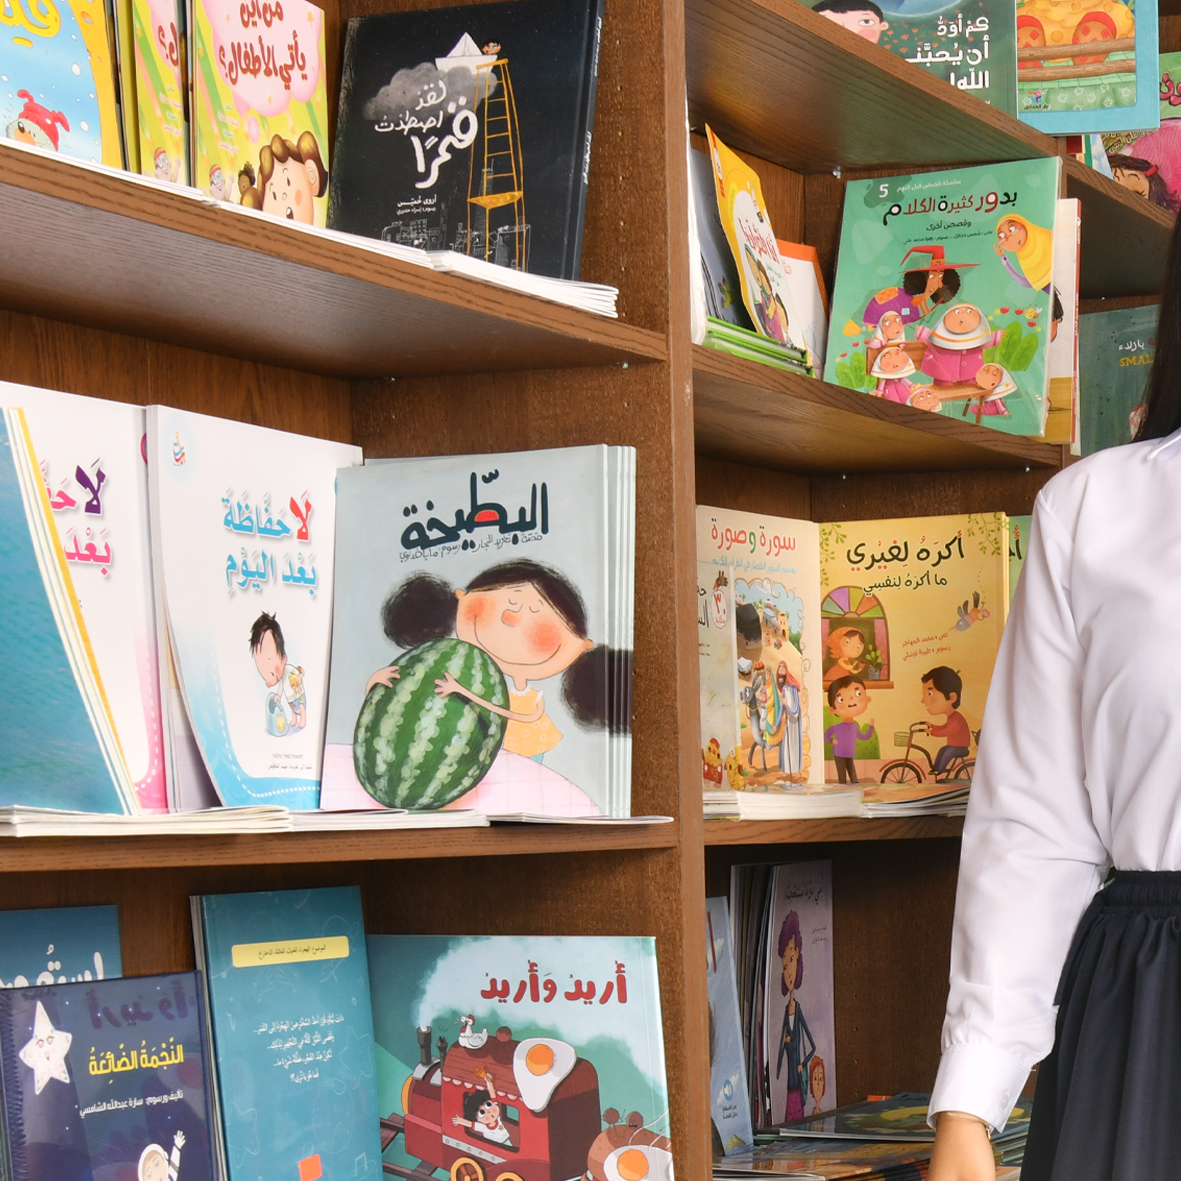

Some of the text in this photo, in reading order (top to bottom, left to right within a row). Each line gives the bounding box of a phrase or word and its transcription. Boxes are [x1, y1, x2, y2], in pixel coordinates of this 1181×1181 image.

[878, 183, 890, 199] 5
[883, 191, 1018, 227] بدور كثيرة الكلام
[1120, 354, 1155, 367] SMAL
